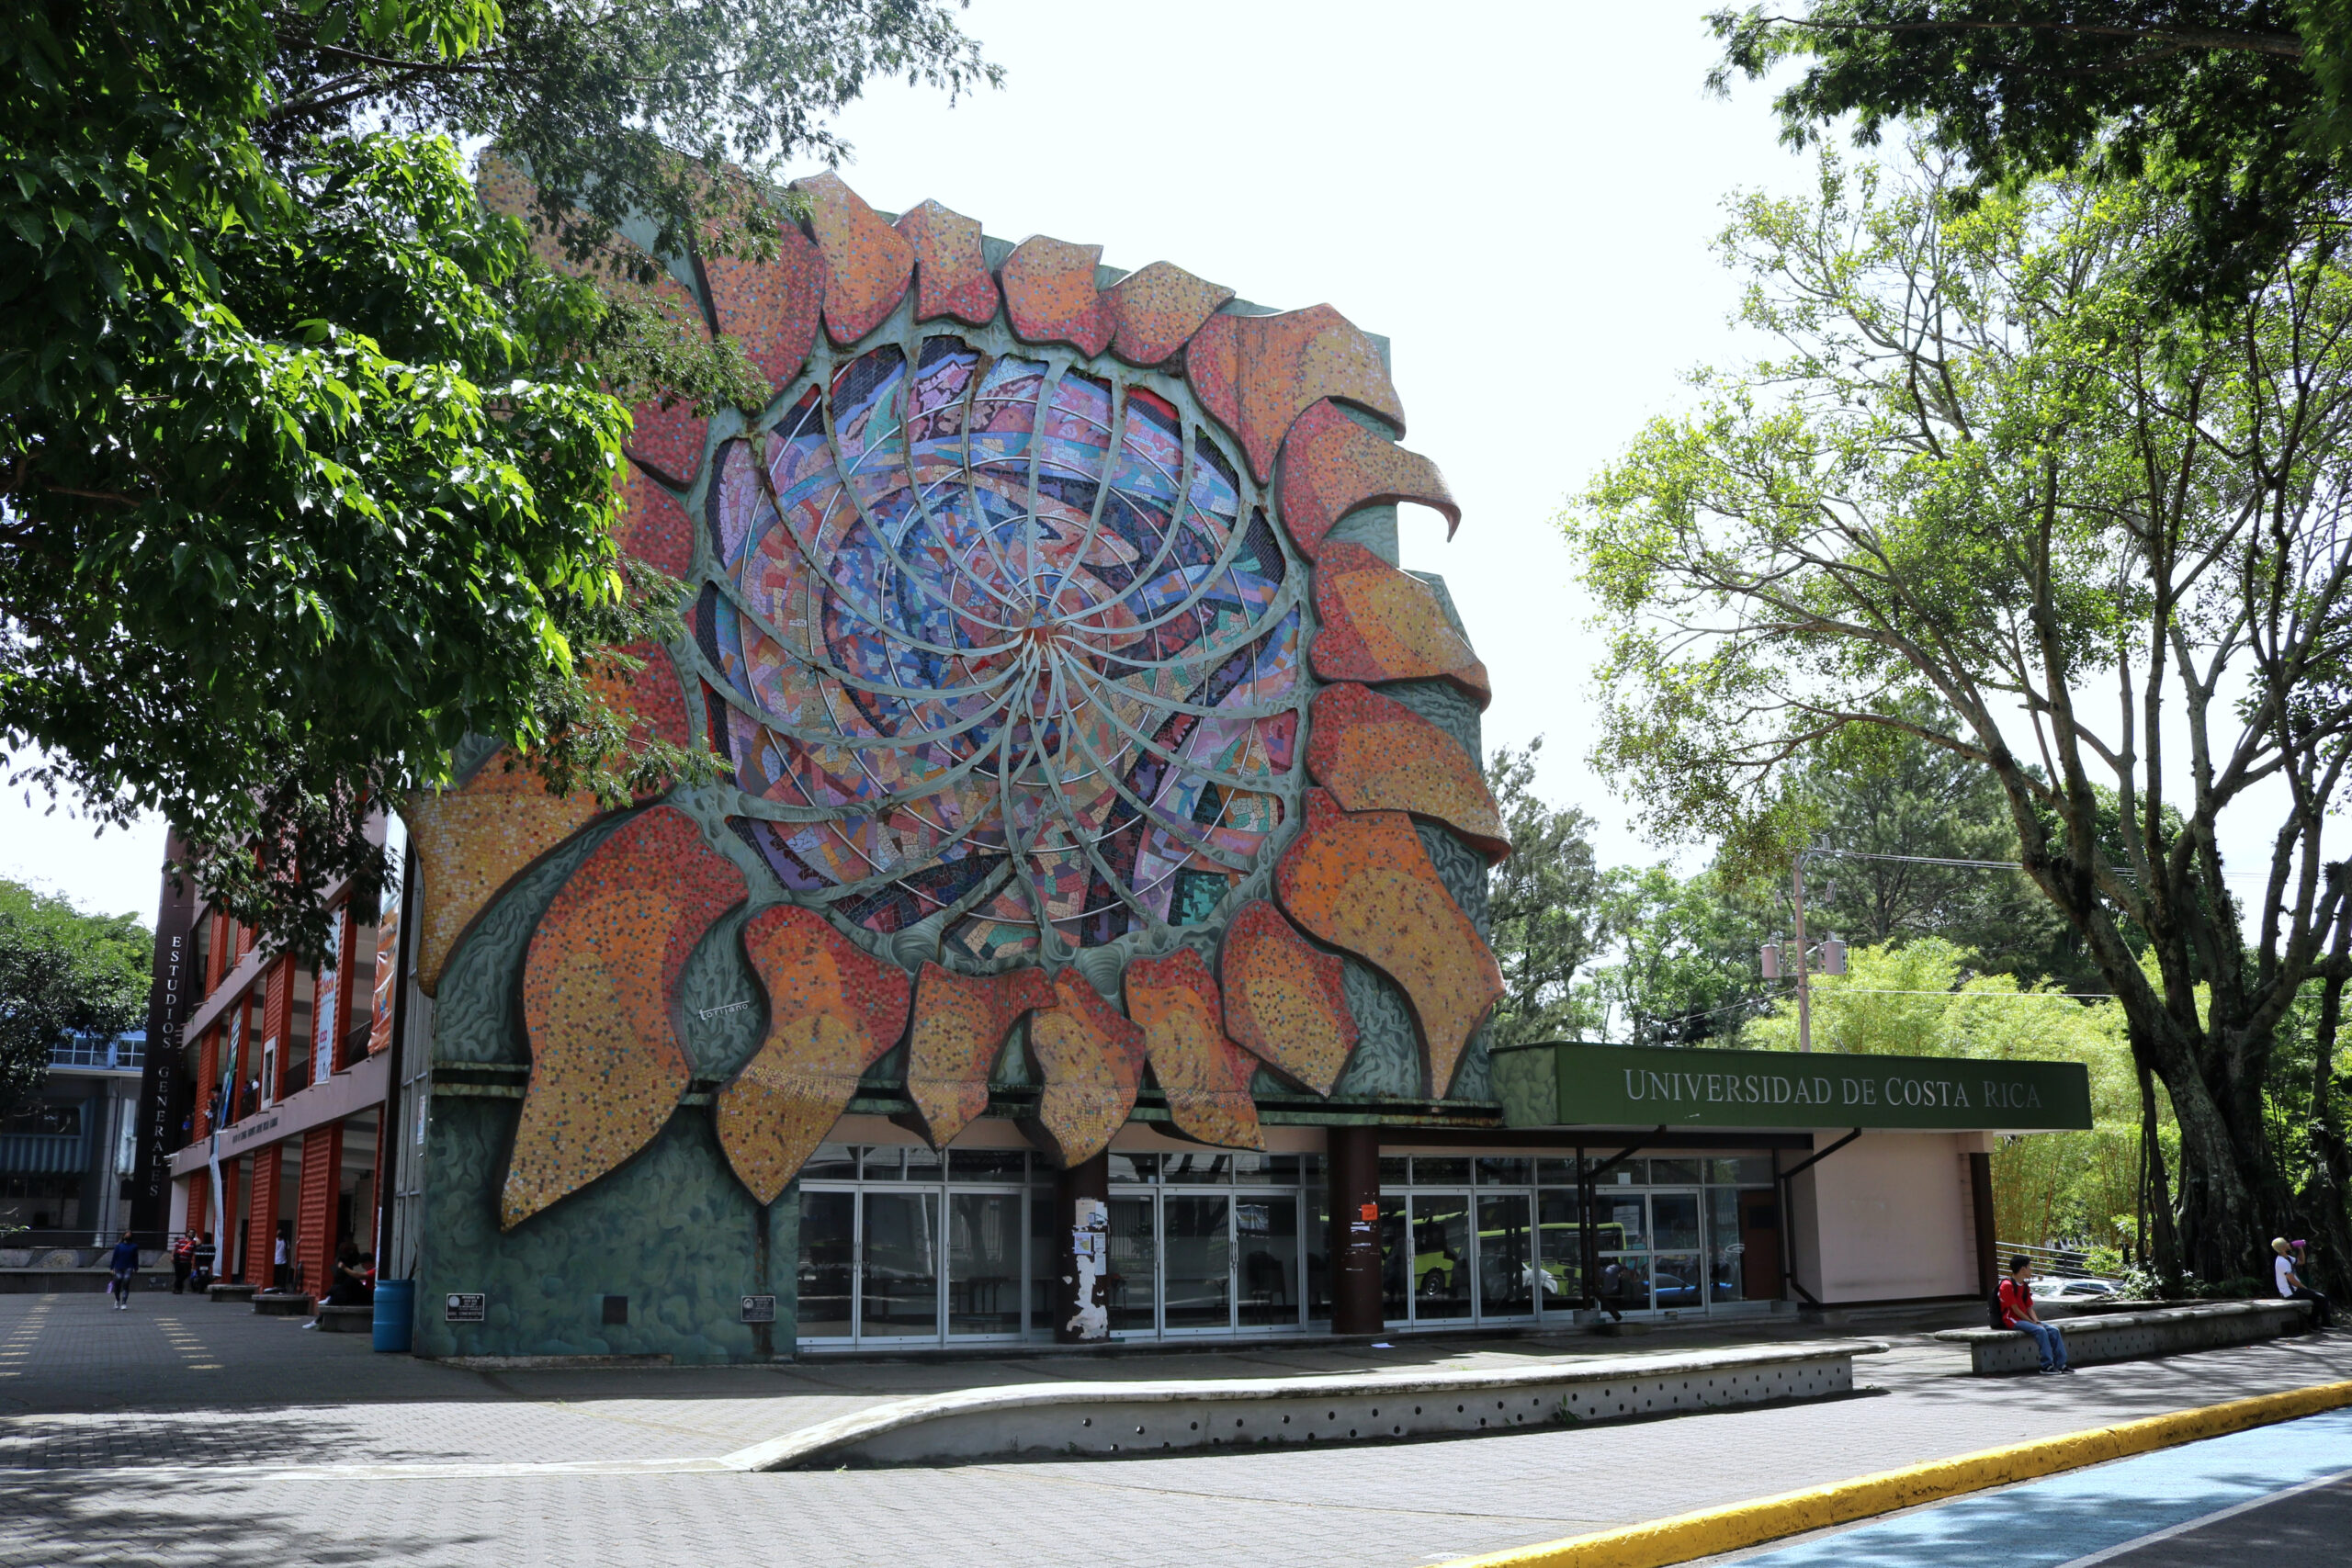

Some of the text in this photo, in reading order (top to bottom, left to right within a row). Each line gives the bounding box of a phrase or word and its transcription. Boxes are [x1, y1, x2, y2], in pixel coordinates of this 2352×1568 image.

[150, 936, 182, 1197] ESTUDIOS GENERALES
[1623, 1068, 2042, 1109] UNIVERSIDAD DE COSTA RICA
